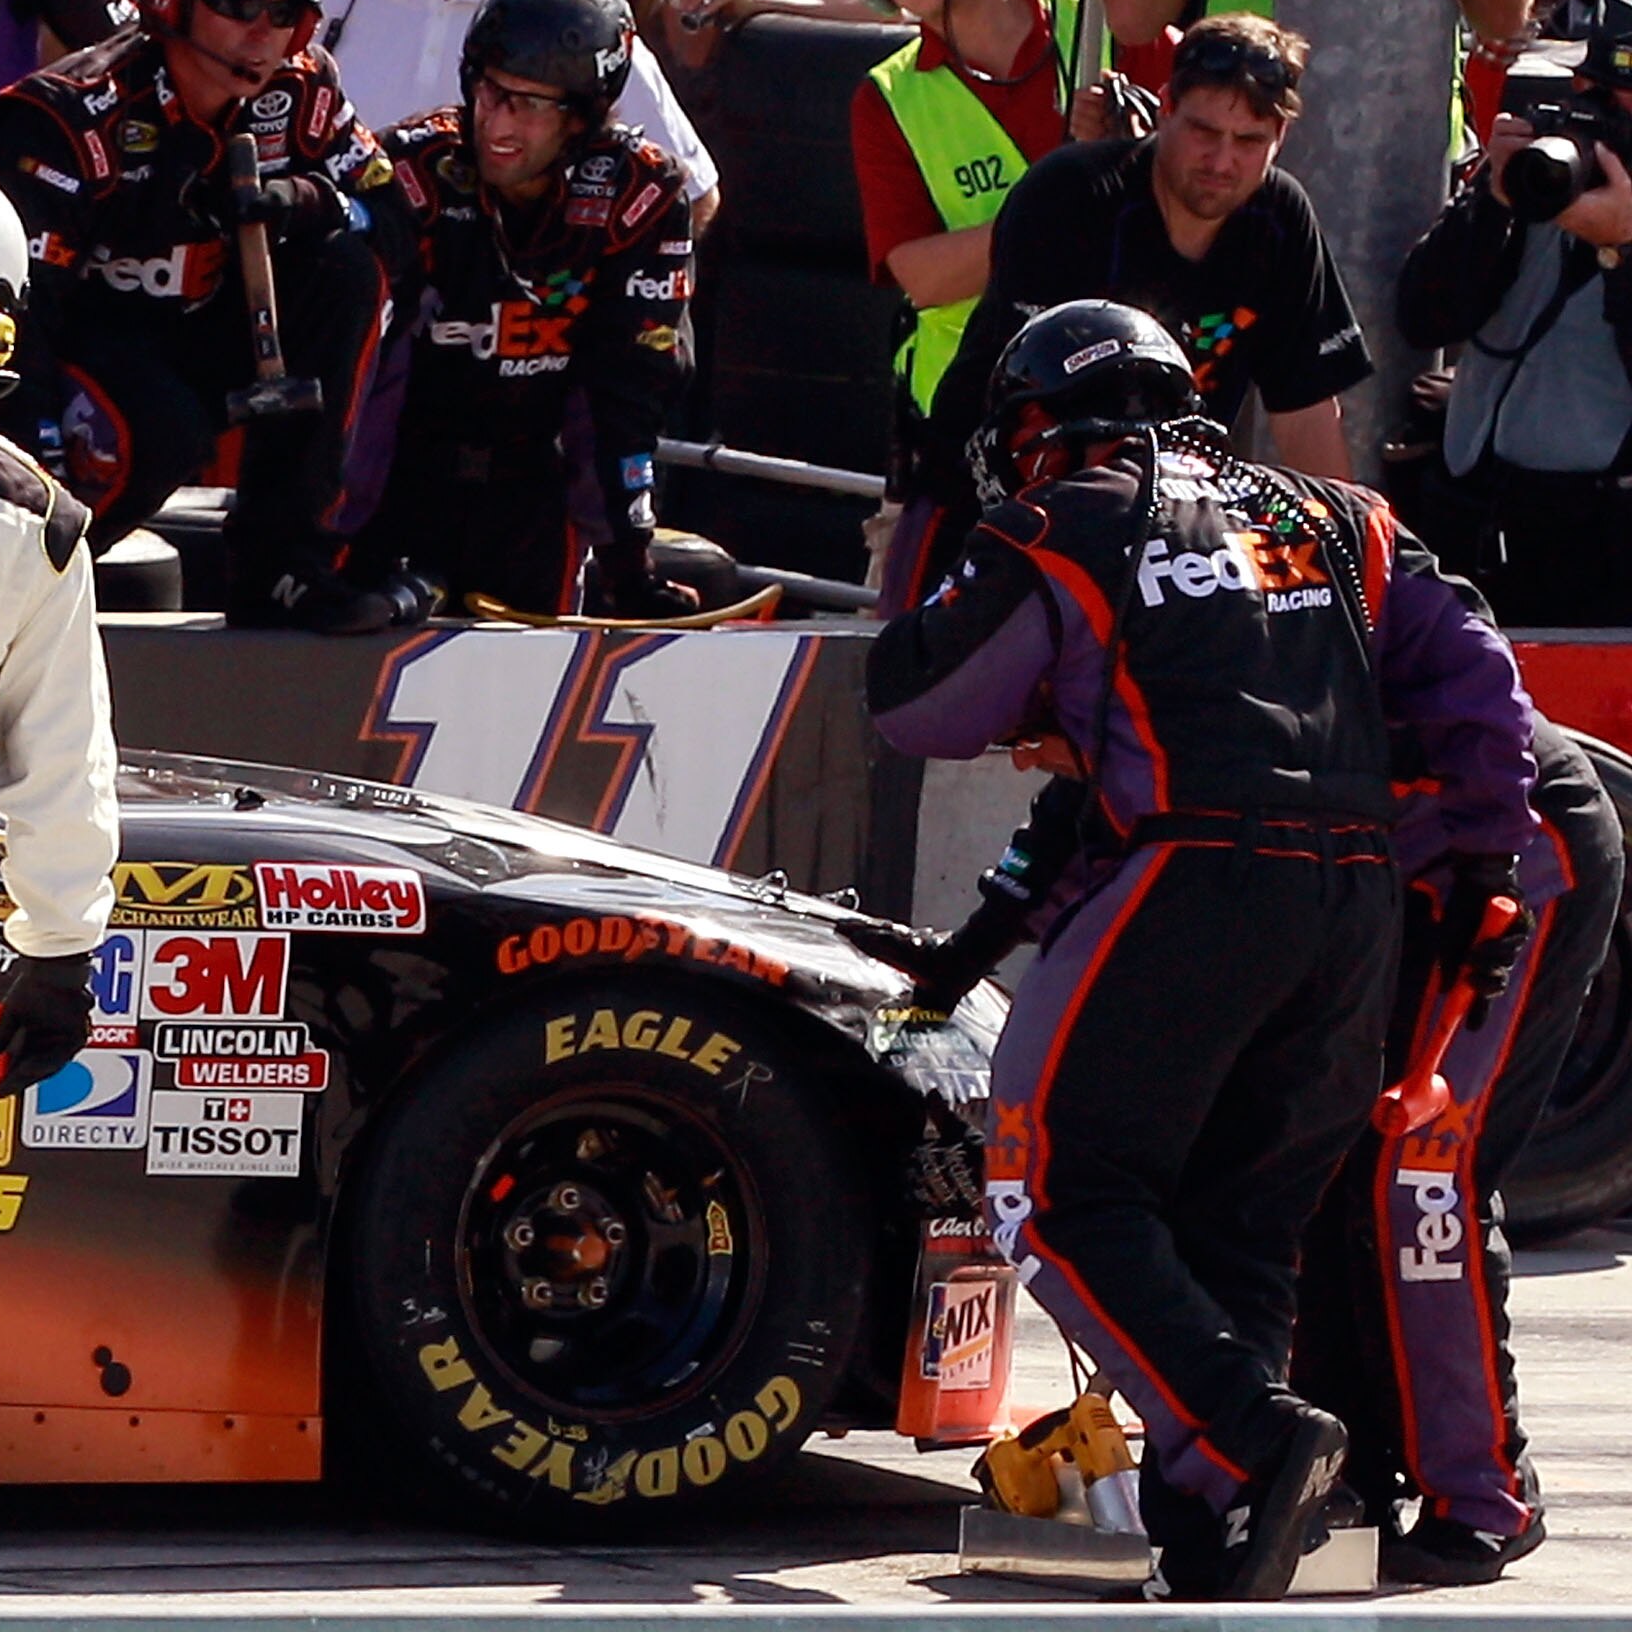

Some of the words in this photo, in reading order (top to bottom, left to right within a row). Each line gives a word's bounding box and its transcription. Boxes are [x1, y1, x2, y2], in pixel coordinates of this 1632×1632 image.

[595, 32, 634, 78] Fed
[83, 76, 123, 117] Fed
[953, 154, 1006, 199] 902
[626, 272, 692, 300] FedE
[430, 301, 573, 359] edEx
[1128, 531, 1330, 607] FedEx
[1267, 588, 1332, 614] RACING
[358, 630, 822, 870] 11
[108, 910, 196, 928] ECHANIX
[197, 908, 257, 928] WEAR
[265, 867, 422, 927] Holley
[266, 910, 301, 925] HP
[306, 911, 394, 928] CARBS
[496, 915, 791, 987] GOODYEAR
[149, 936, 279, 1016] 3M
[163, 1030, 299, 1057] LINCOLN
[544, 1008, 741, 1076] EAGLE
[191, 1063, 311, 1085] WELDERS
[32, 1125, 136, 1143] DIRECTV
[154, 1127, 298, 1157] TISSOT
[1396, 1098, 1477, 1283] FedEx
[419, 1336, 802, 1506] GOODYEAR
